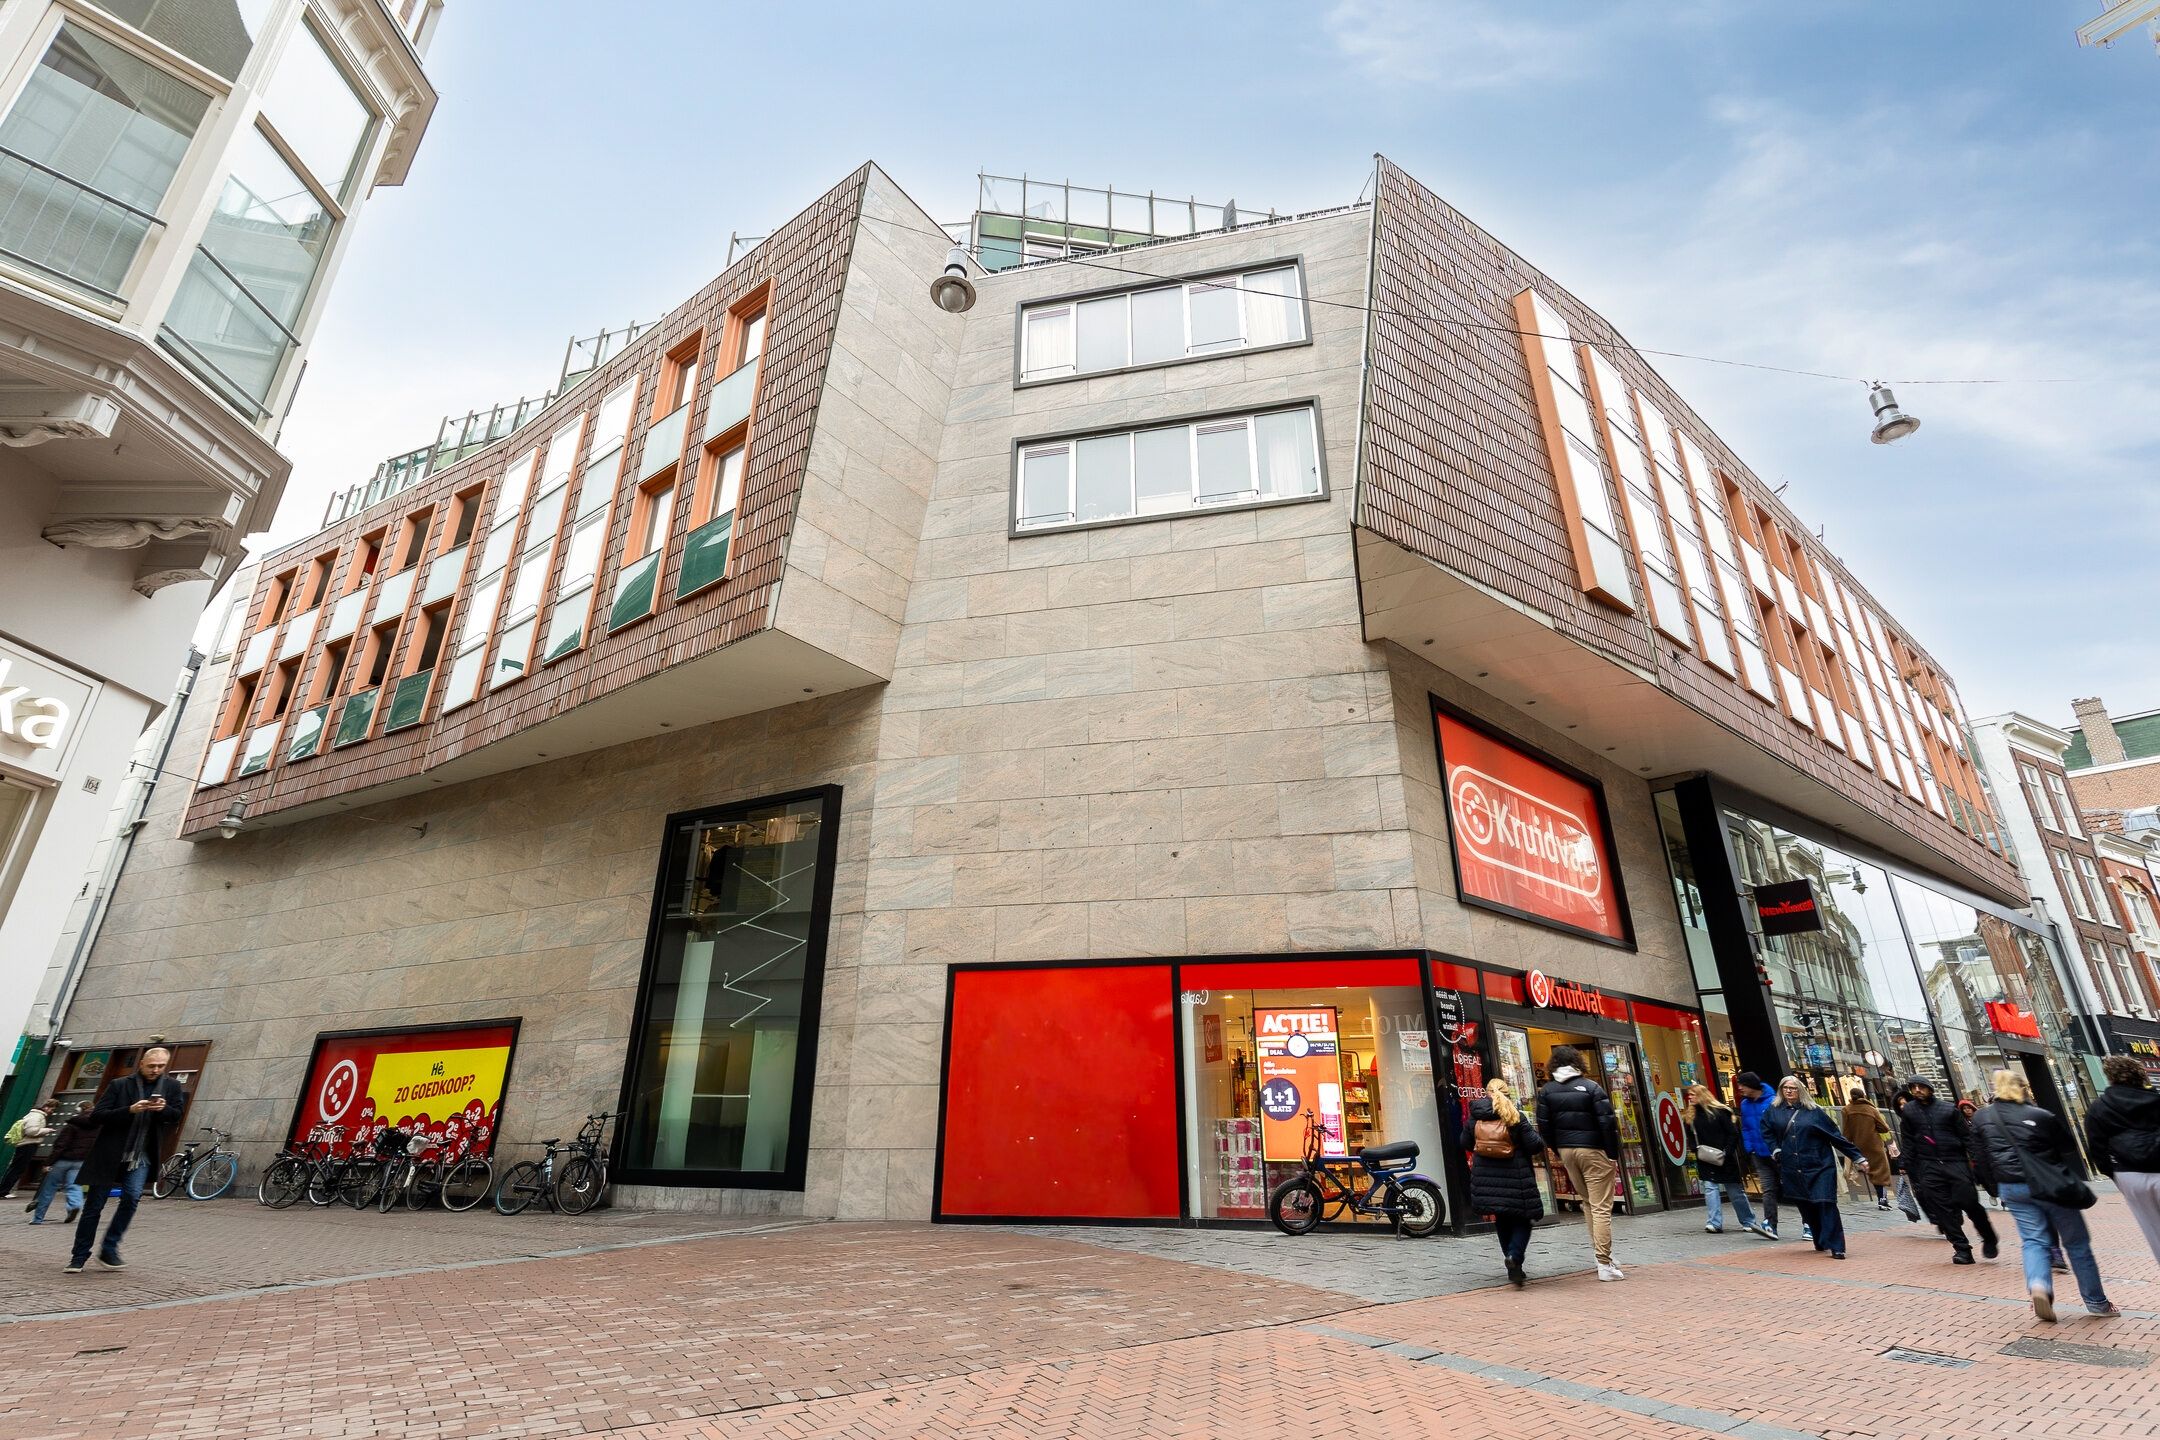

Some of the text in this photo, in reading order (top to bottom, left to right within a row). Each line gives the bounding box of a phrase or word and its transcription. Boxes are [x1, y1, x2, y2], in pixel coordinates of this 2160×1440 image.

[84, 778, 99, 792] 164
[1546, 976, 1605, 1015] Kruidvat
[1262, 1013, 1330, 1033] ACTIE!
[394, 1074, 476, 1104] ZO GOEDKOOP?
[1269, 1105, 1293, 1113] GRATIS
